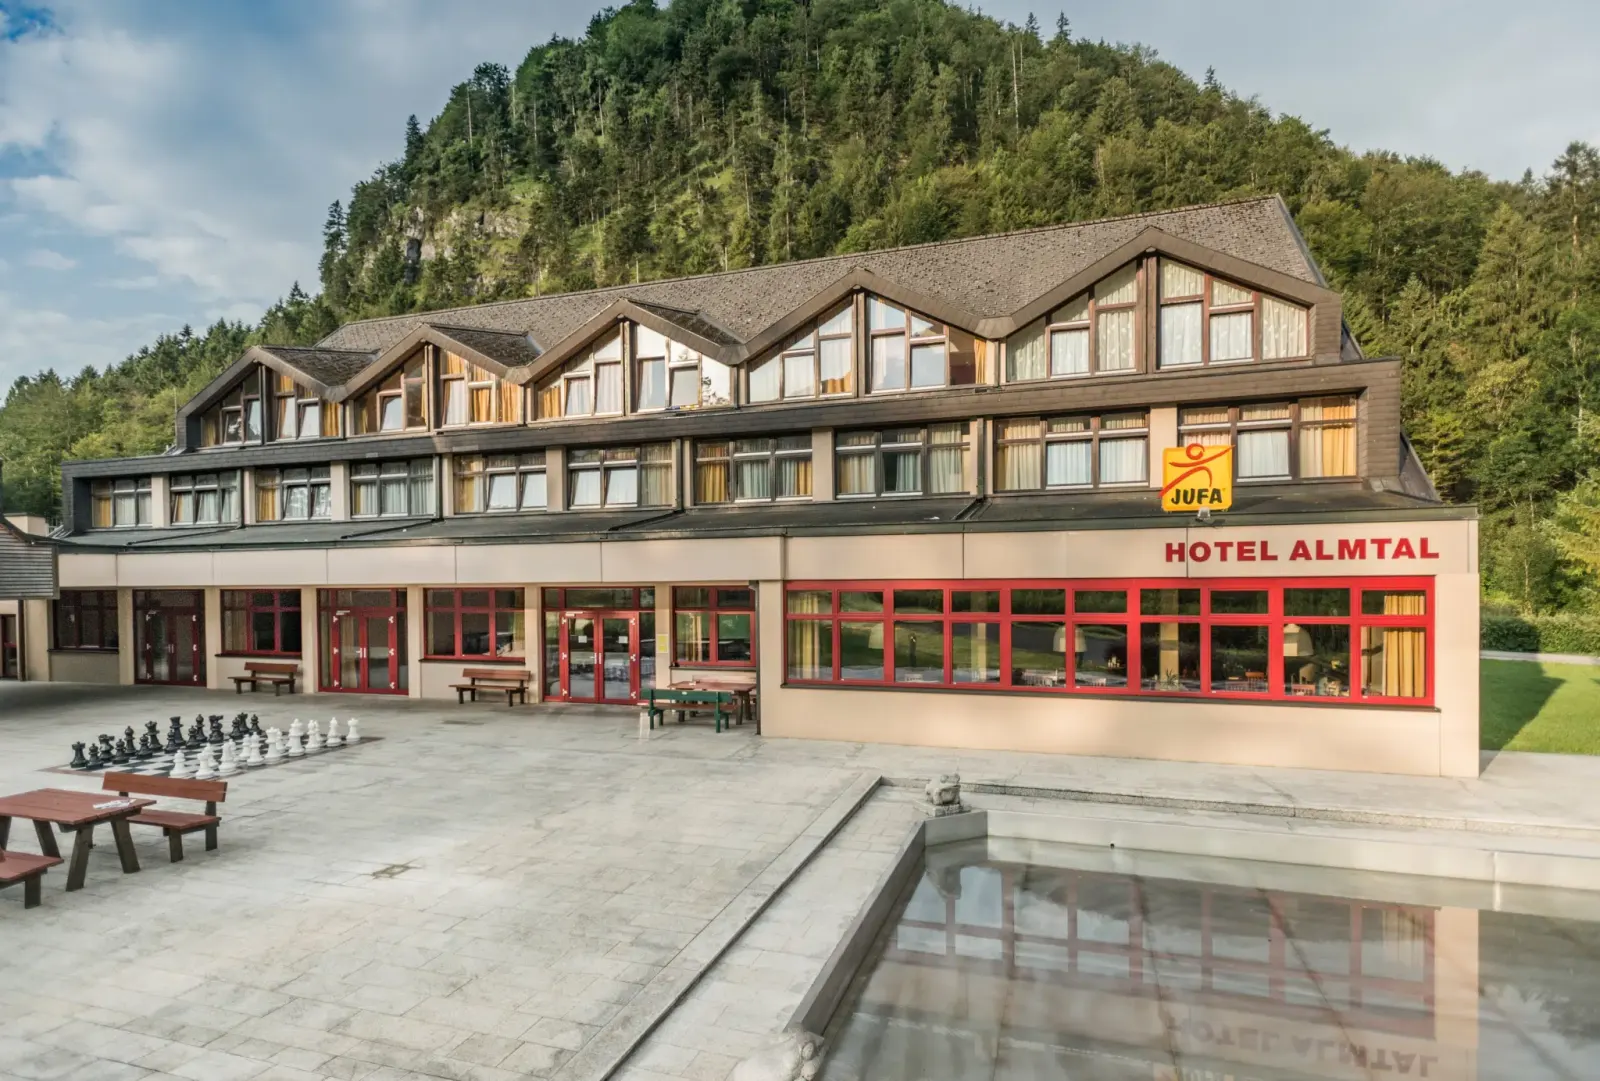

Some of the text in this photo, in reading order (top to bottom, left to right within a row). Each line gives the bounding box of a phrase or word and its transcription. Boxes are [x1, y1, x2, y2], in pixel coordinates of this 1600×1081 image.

[1171, 488, 1222, 505] JUFA
[1165, 538, 1439, 562] HOTEL ALMTAL
